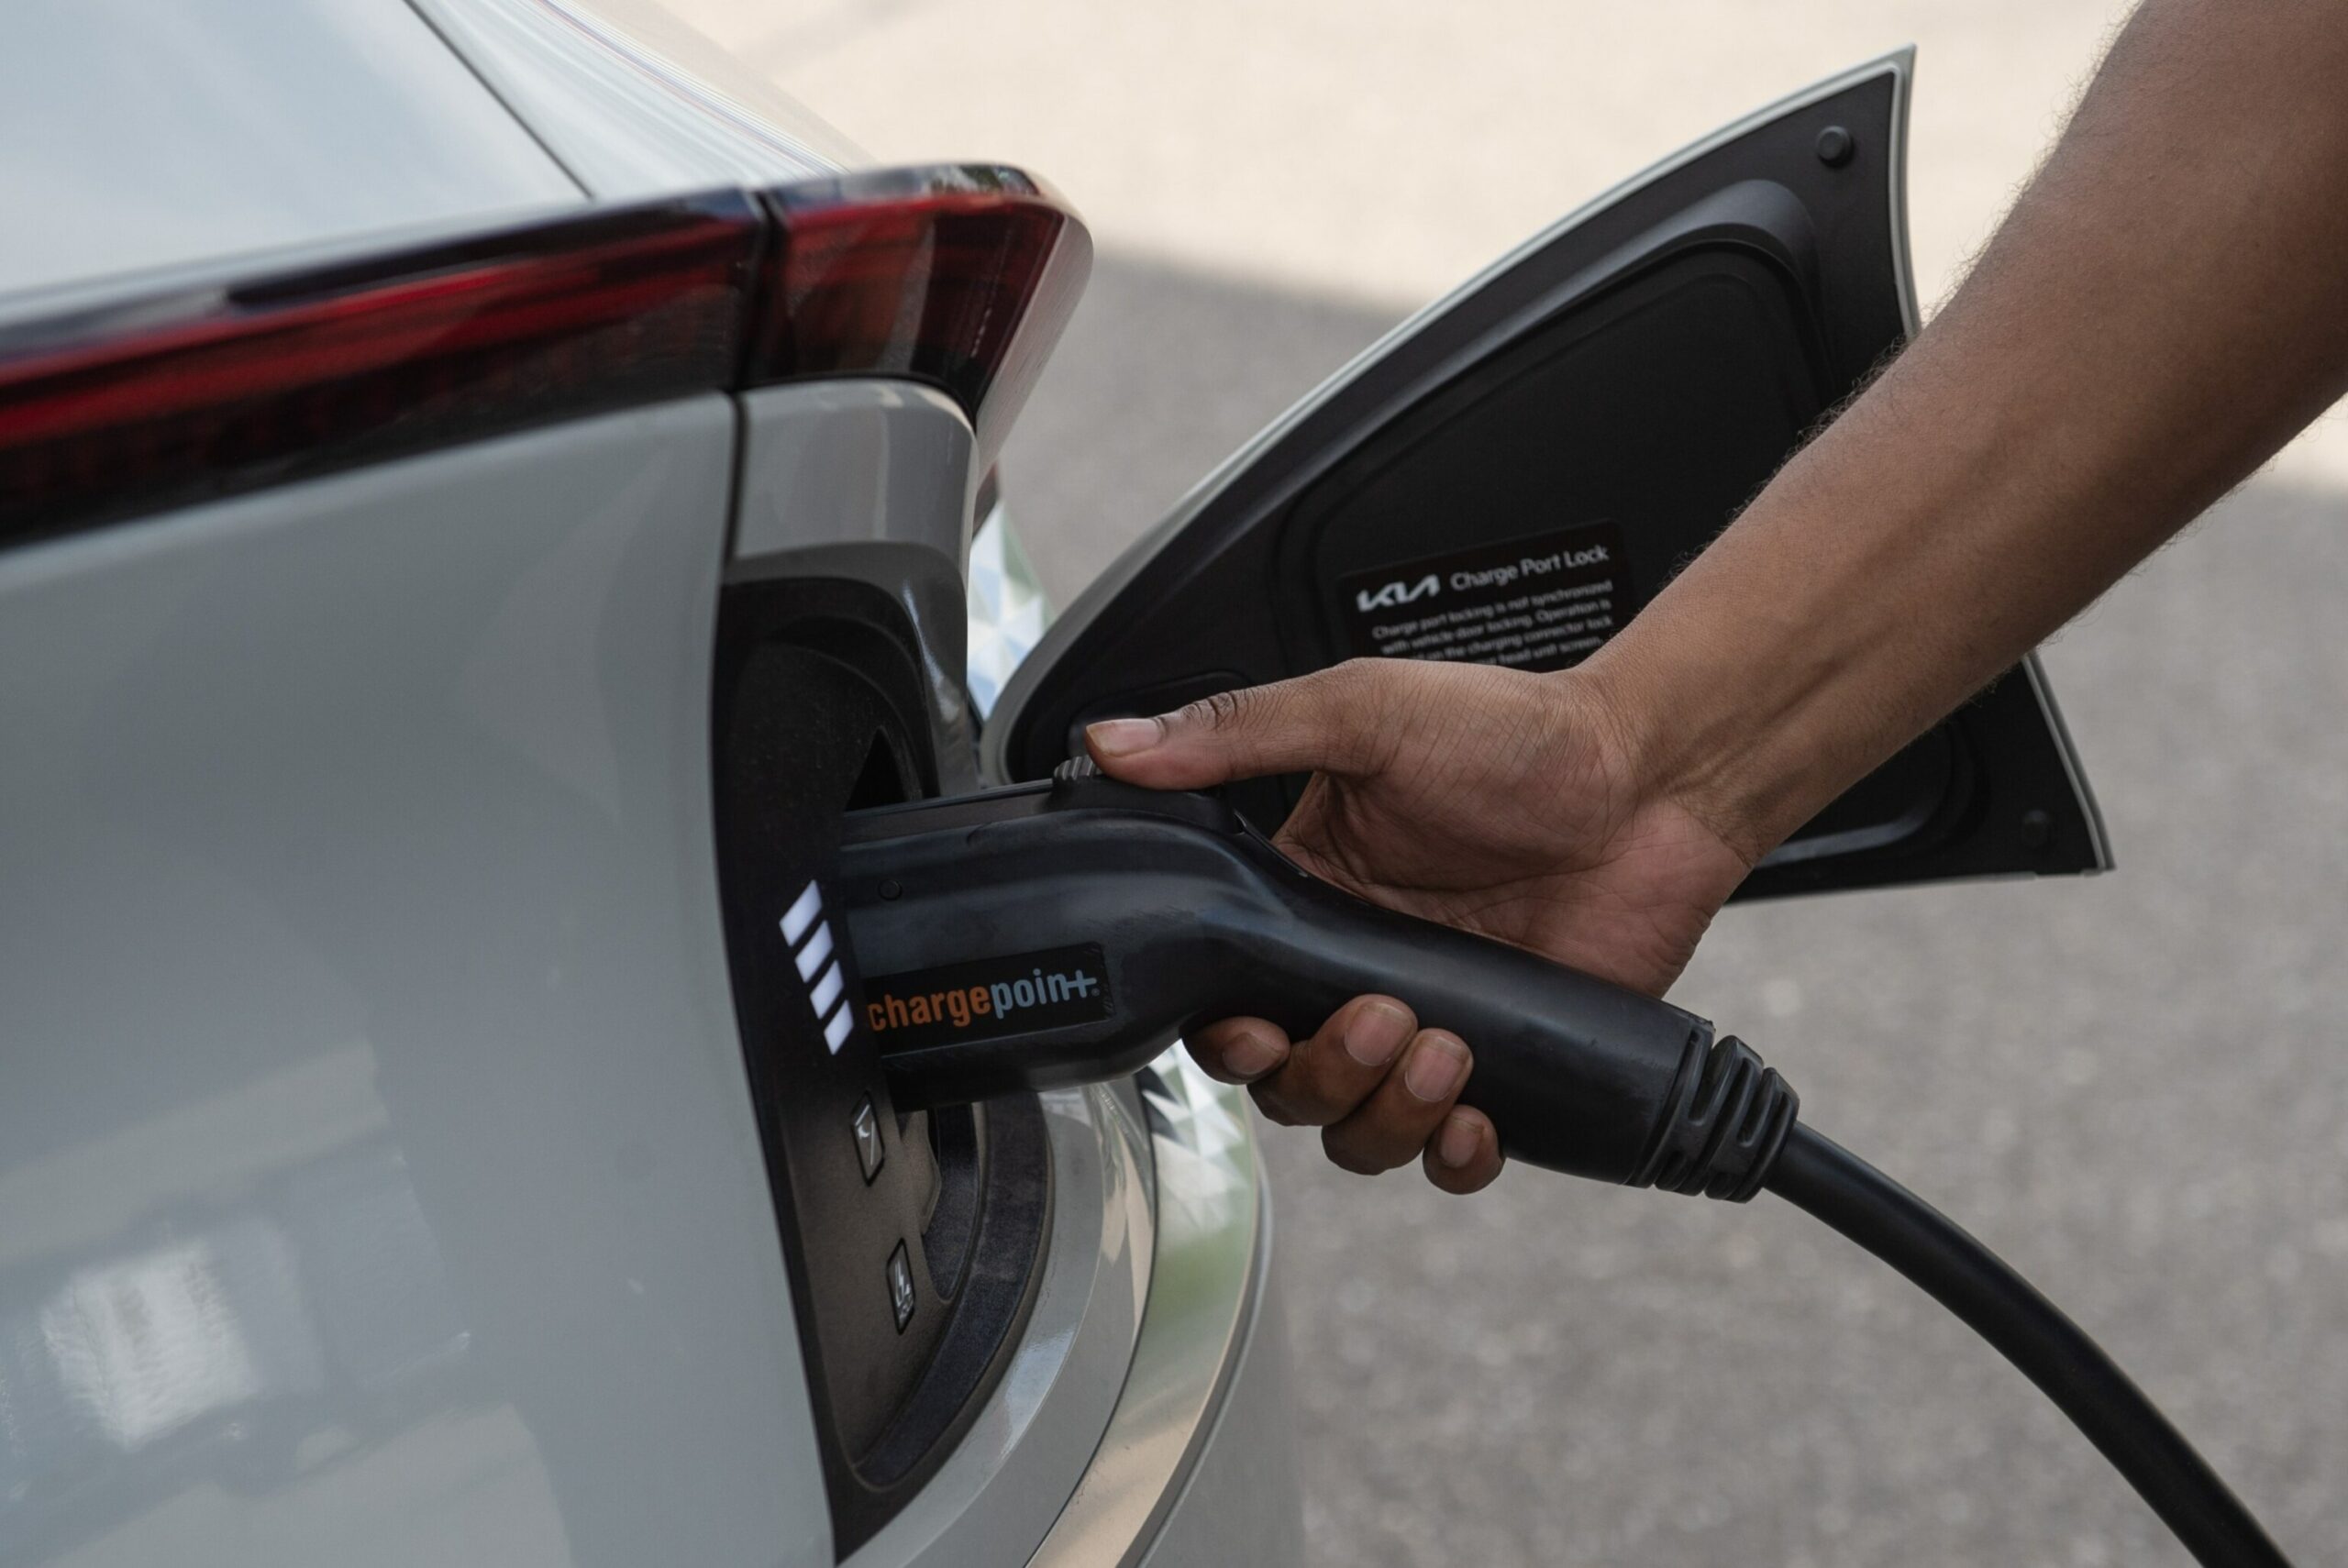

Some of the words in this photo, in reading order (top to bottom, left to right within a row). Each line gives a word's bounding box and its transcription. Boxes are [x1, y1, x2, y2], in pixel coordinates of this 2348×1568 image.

[1357, 574, 1440, 613] KIA
[1450, 565, 1518, 591] Charge
[1520, 554, 1560, 576] Port
[1563, 545, 1609, 569] Lock
[1372, 621, 1418, 640] Charge
[1420, 613, 1447, 631] port
[1448, 604, 1494, 624] locking
[1495, 602, 1506, 613] is
[1507, 596, 1529, 611] not
[1531, 579, 1612, 607] synchronized
[1380, 639, 1410, 655] with
[1412, 631, 1454, 648] vehicle
[1455, 624, 1484, 640] door
[1486, 614, 1534, 633] locking.
[1534, 601, 1599, 624] Operation
[1599, 598, 1611, 611] is
[1444, 646, 1467, 658] the
[1468, 634, 1523, 655] charging
[1523, 623, 1584, 643] connector
[1586, 614, 1612, 630] lock
[1498, 647, 1531, 664] head
[1532, 643, 1557, 659] unit
